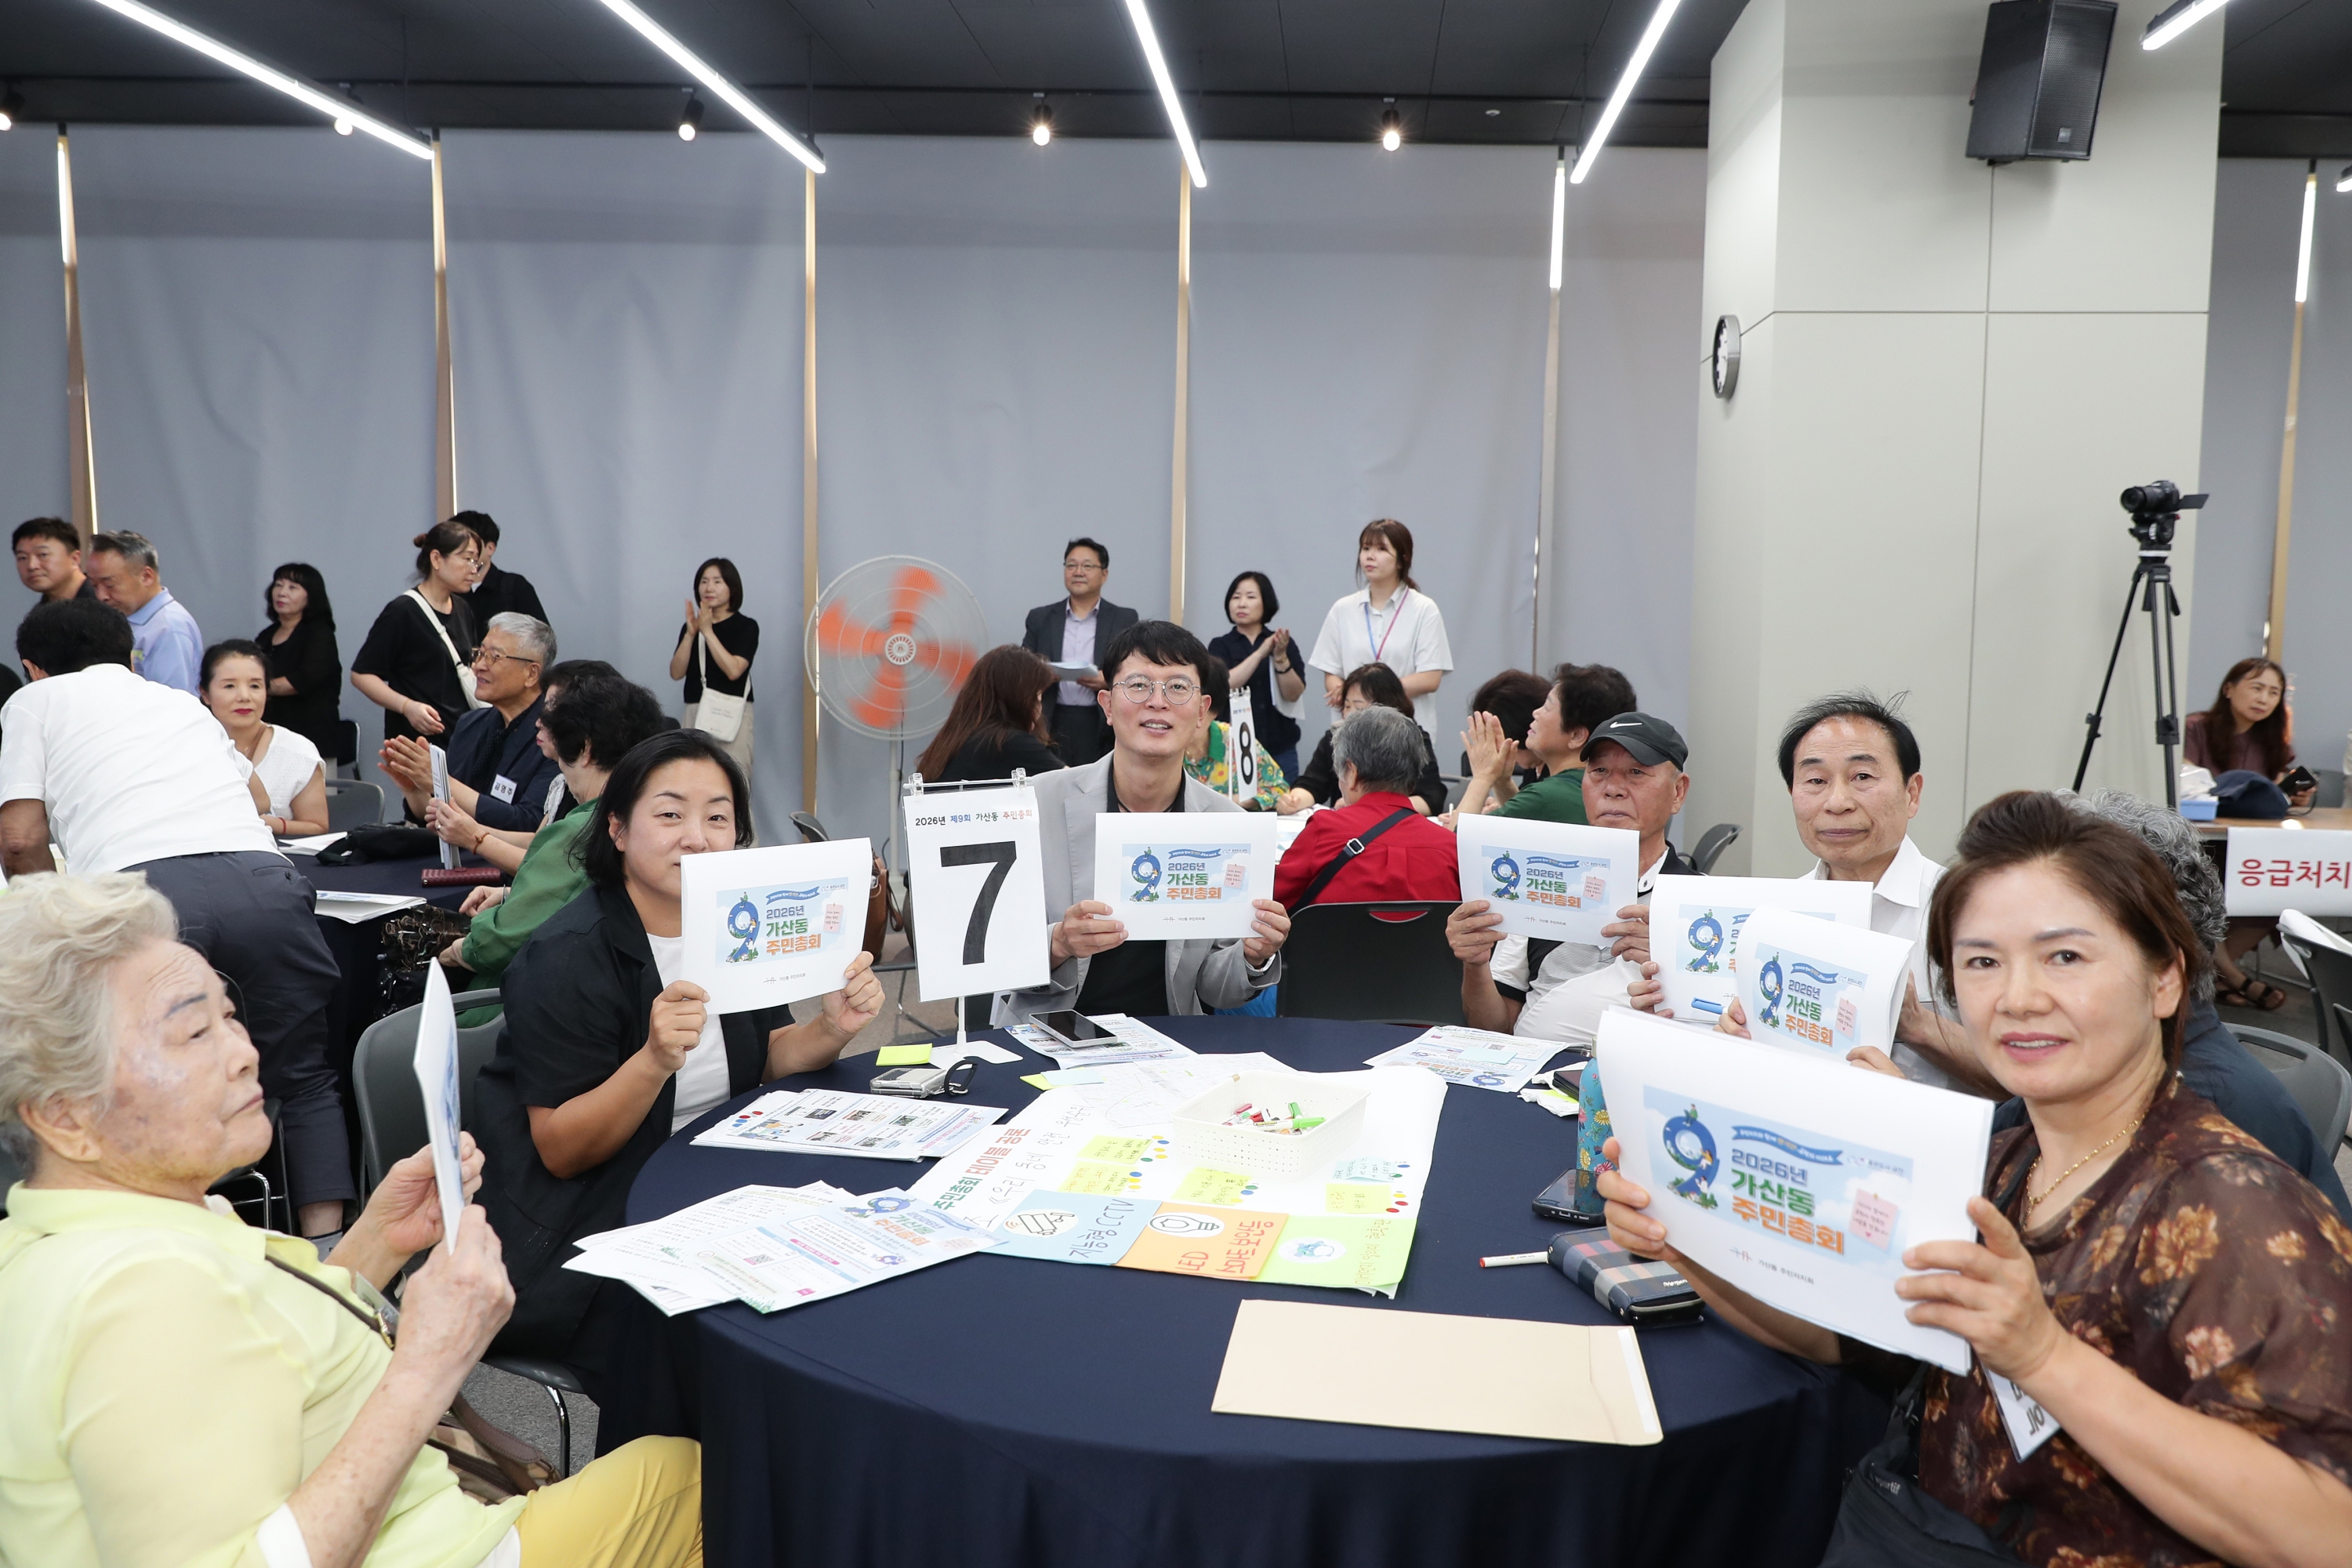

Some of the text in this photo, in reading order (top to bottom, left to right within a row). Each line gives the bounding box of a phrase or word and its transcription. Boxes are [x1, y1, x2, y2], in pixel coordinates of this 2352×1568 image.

[1239, 721, 1254, 785] 8
[915, 809, 1033, 826] 2026년 제9회 가산동 주민총회
[1131, 854, 1162, 902] 9
[1167, 862, 1206, 872] 2026년
[1167, 873, 1209, 886] 가산동
[1491, 856, 1521, 901] 9
[1526, 867, 1564, 880] 2026년
[2238, 858, 2350, 888] 응급처치
[1166, 887, 1222, 900] 주민총회
[1526, 877, 1567, 895] 가산동
[1526, 891, 1582, 909] 주민총회
[765, 905, 805, 920] 2026년
[940, 840, 1018, 965] 7
[727, 901, 760, 963] 9
[765, 919, 809, 938] 가산동
[765, 933, 822, 956] 주민총회
[1759, 960, 1784, 1026] 9
[1788, 979, 1821, 1000] 2026년
[1786, 993, 1821, 1022] 가산동
[1784, 1014, 1834, 1047] 주민총회
[932, 1176, 983, 1210] 주민총회
[964, 1147, 1012, 1175] 테이블
[995, 1128, 1032, 1144] 공론
[1014, 1152, 1054, 1171] 동네
[1662, 1116, 1720, 1209] 9
[1730, 1148, 1809, 1188] 2026년
[1731, 1168, 1816, 1218] 가산동
[873, 1218, 931, 1247] 주민총회
[889, 1214, 936, 1235] 가산동
[1069, 1229, 1118, 1259] 지능형
[1095, 1199, 1134, 1227] CCTV
[1731, 1195, 1845, 1255] 주민총회
[1174, 1250, 1209, 1271] LED
